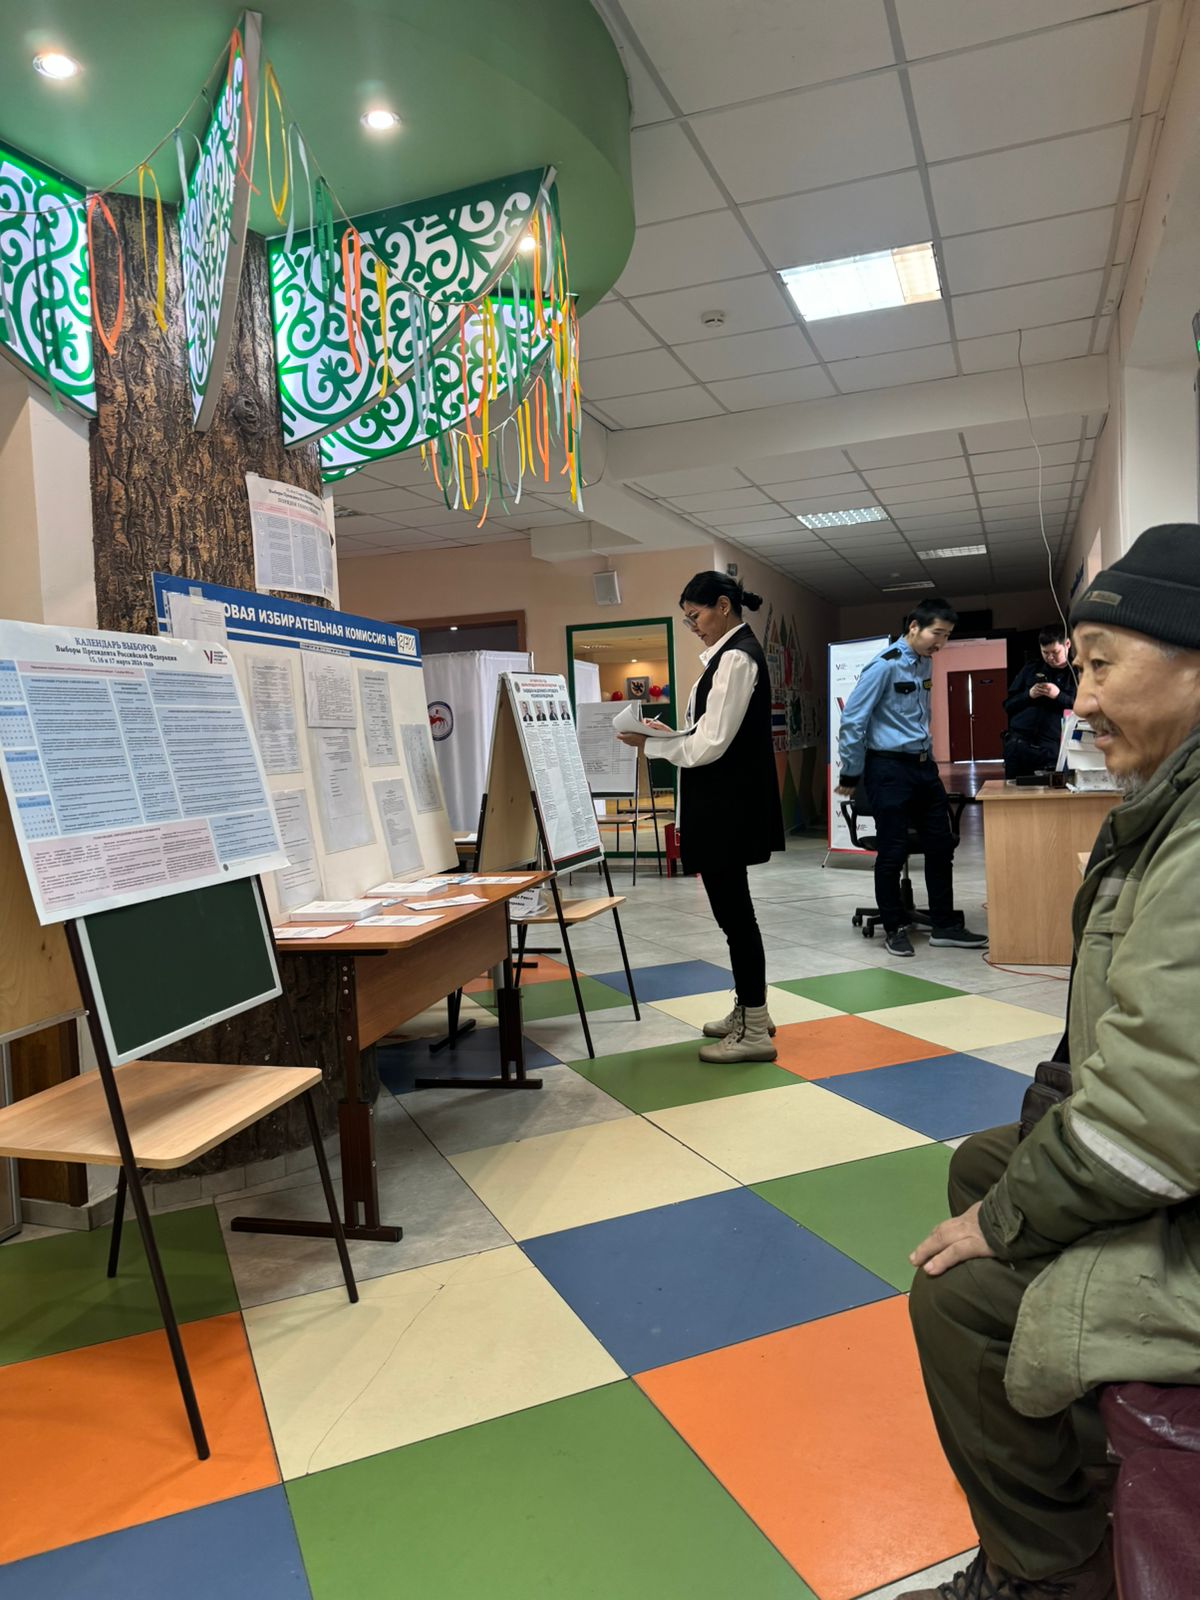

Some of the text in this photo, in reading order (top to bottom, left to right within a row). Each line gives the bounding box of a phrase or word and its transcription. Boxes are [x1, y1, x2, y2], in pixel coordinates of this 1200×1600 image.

[224, 602, 256, 621] ОВАЯ
[258, 609, 343, 637] ИЗБИРАТЕЛЬНАЯ
[345, 626, 387, 646] КОМИССИЯ
[387, 635, 396, 647] №
[74, 637, 157, 652] КАЛЕНДАРЬ ВЫБОРОВ
[55, 645, 177, 662] Выборы Президента Российской Федерации
